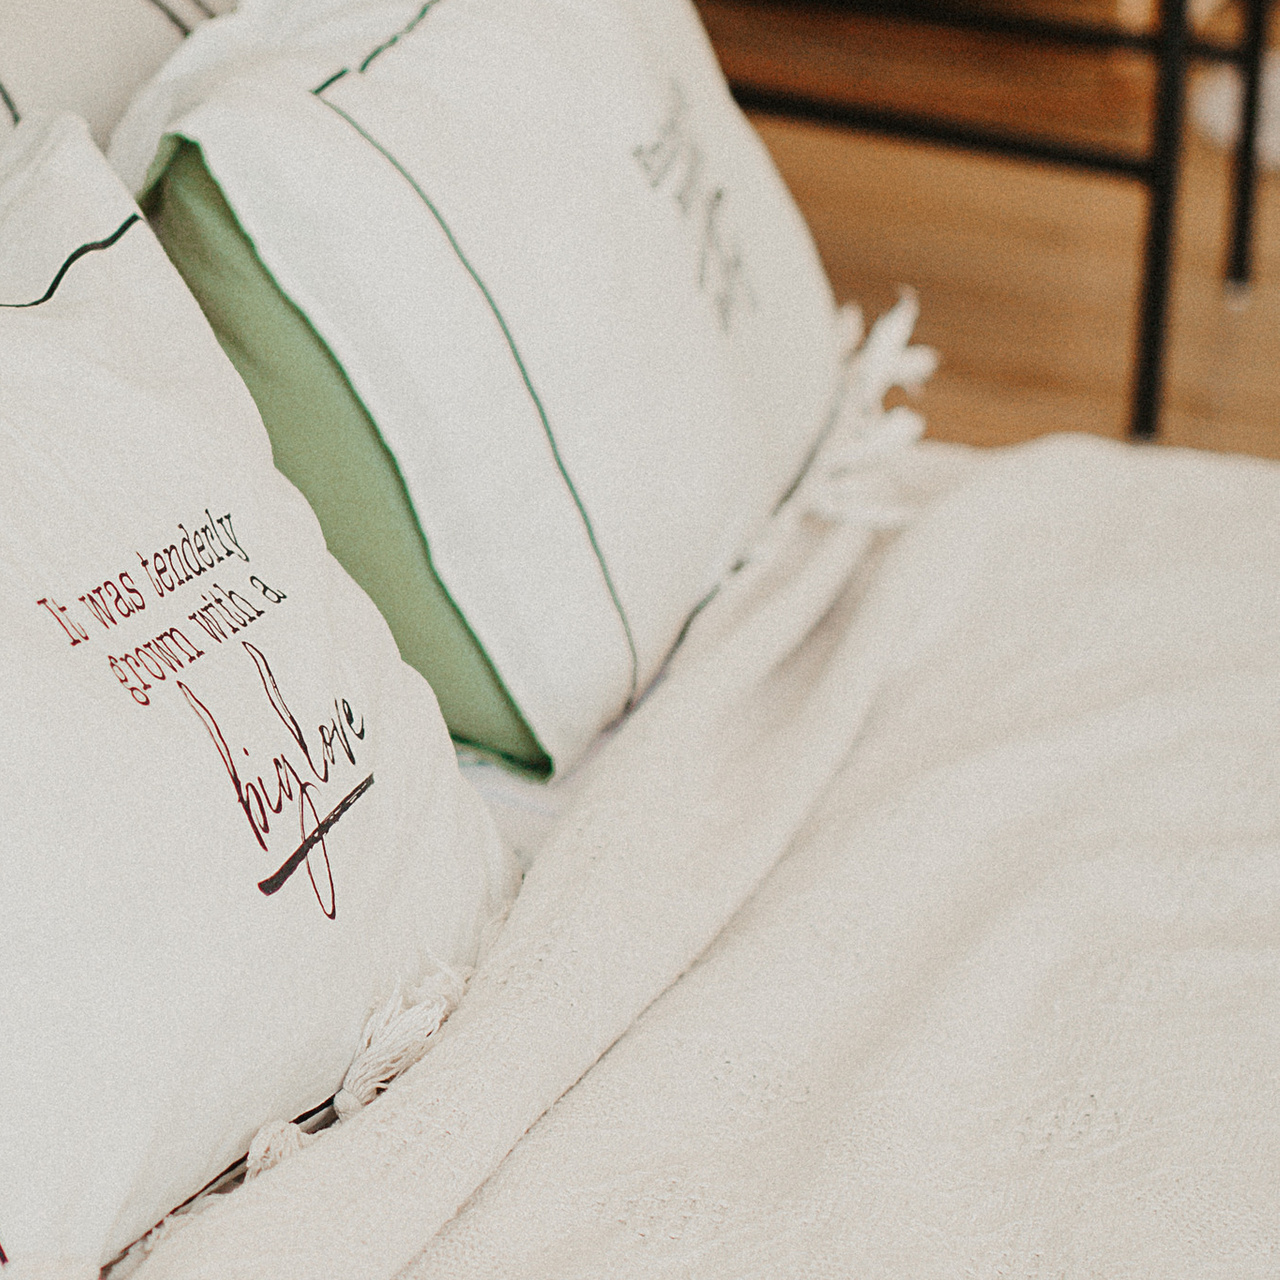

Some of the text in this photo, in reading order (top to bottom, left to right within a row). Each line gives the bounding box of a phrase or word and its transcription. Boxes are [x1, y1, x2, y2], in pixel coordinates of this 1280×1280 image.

[37, 508, 250, 646] It was tenderly
[108, 575, 287, 706] grown with a
